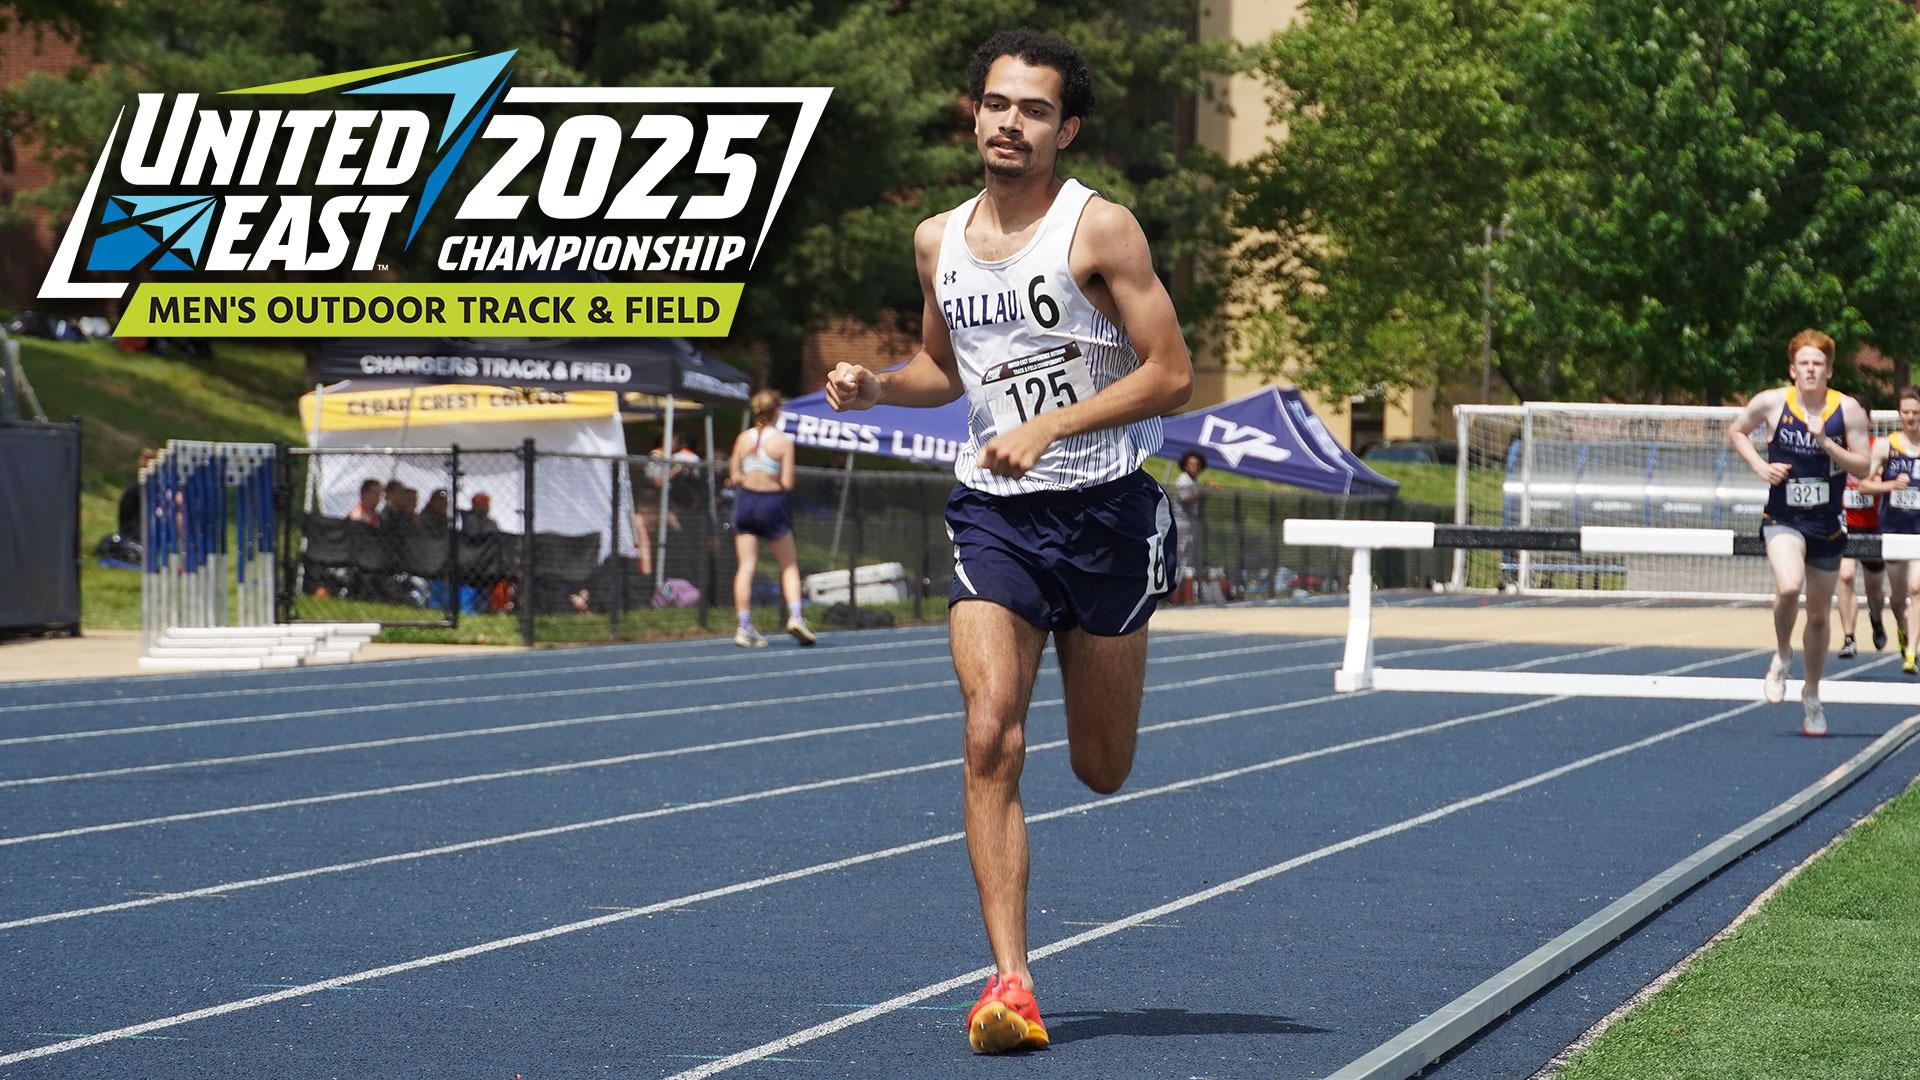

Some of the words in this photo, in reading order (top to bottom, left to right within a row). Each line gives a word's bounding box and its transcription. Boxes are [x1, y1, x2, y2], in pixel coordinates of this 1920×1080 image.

[943, 289, 1025, 331] GALLAU
[1028, 275, 1060, 329] 6
[359, 354, 479, 377] CHARGERS
[480, 357, 551, 380] TRACK
[552, 360, 569, 380] &
[570, 361, 632, 384] FIELD
[347, 397, 410, 415] CEDAR
[418, 393, 479, 411] CREST
[1005, 369, 1078, 425] 125
[776, 411, 882, 453] CROSS
[1793, 485, 1822, 503] 321
[1153, 536, 1165, 591] 6
